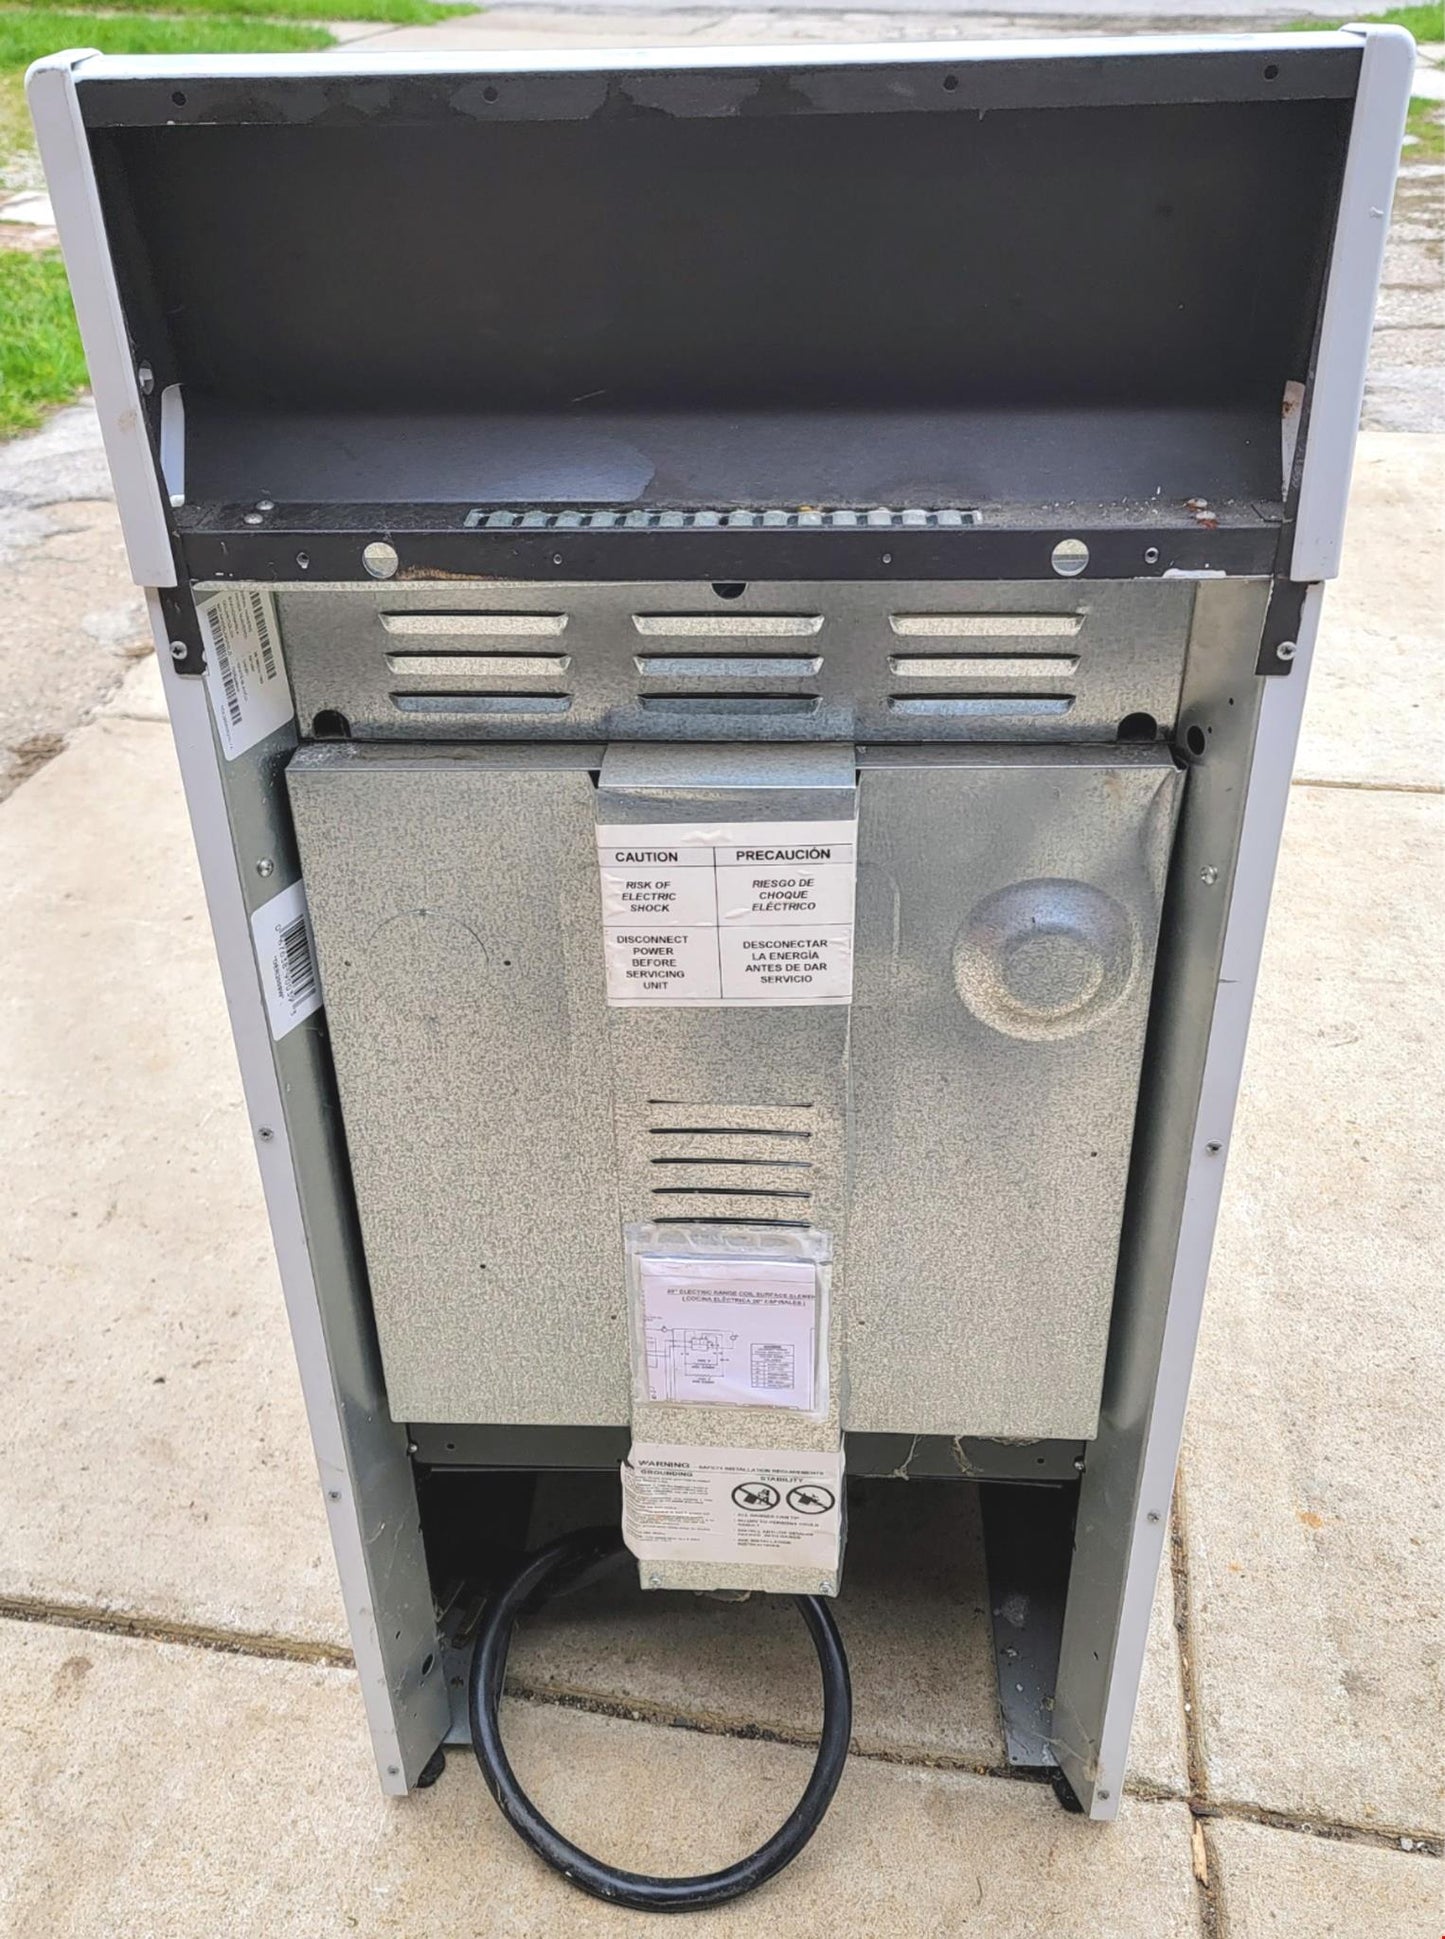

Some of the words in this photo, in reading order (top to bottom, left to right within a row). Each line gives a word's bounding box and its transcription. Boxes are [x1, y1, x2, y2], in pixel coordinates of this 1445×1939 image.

[615, 852, 678, 862] CAUTION
[736, 847, 831, 861] PRECAUCIÓN
[625, 881, 651, 889] RISK
[655, 881, 671, 889] OF
[752, 879, 795, 888] RIESGO
[799, 879, 815, 887] DE
[622, 892, 676, 901] ELECTRIC
[759, 891, 809, 899] CHOQUE
[630, 904, 670, 912] SHOCK
[751, 901, 816, 911] ELÉCTRICO
[616, 935, 688, 944] DISCONNECT
[743, 940, 828, 948] DESCONECTAR
[633, 947, 674, 955] POWER
[752, 952, 766, 961] LA
[769, 950, 819, 960] ENERGÍA
[632, 959, 677, 967] BEFORE
[745, 964, 782, 972] ANTES
[785, 963, 801, 971] DE
[804, 962, 827, 971] DAR
[626, 970, 685, 978] SERVICING
[760, 975, 813, 983] SERVICIO
[644, 982, 668, 990] UNIT
[679, 1288, 712, 1296] ELECTRIC
[638, 1460, 690, 1469] WARNING
[640, 1469, 693, 1477] GROUNDING
